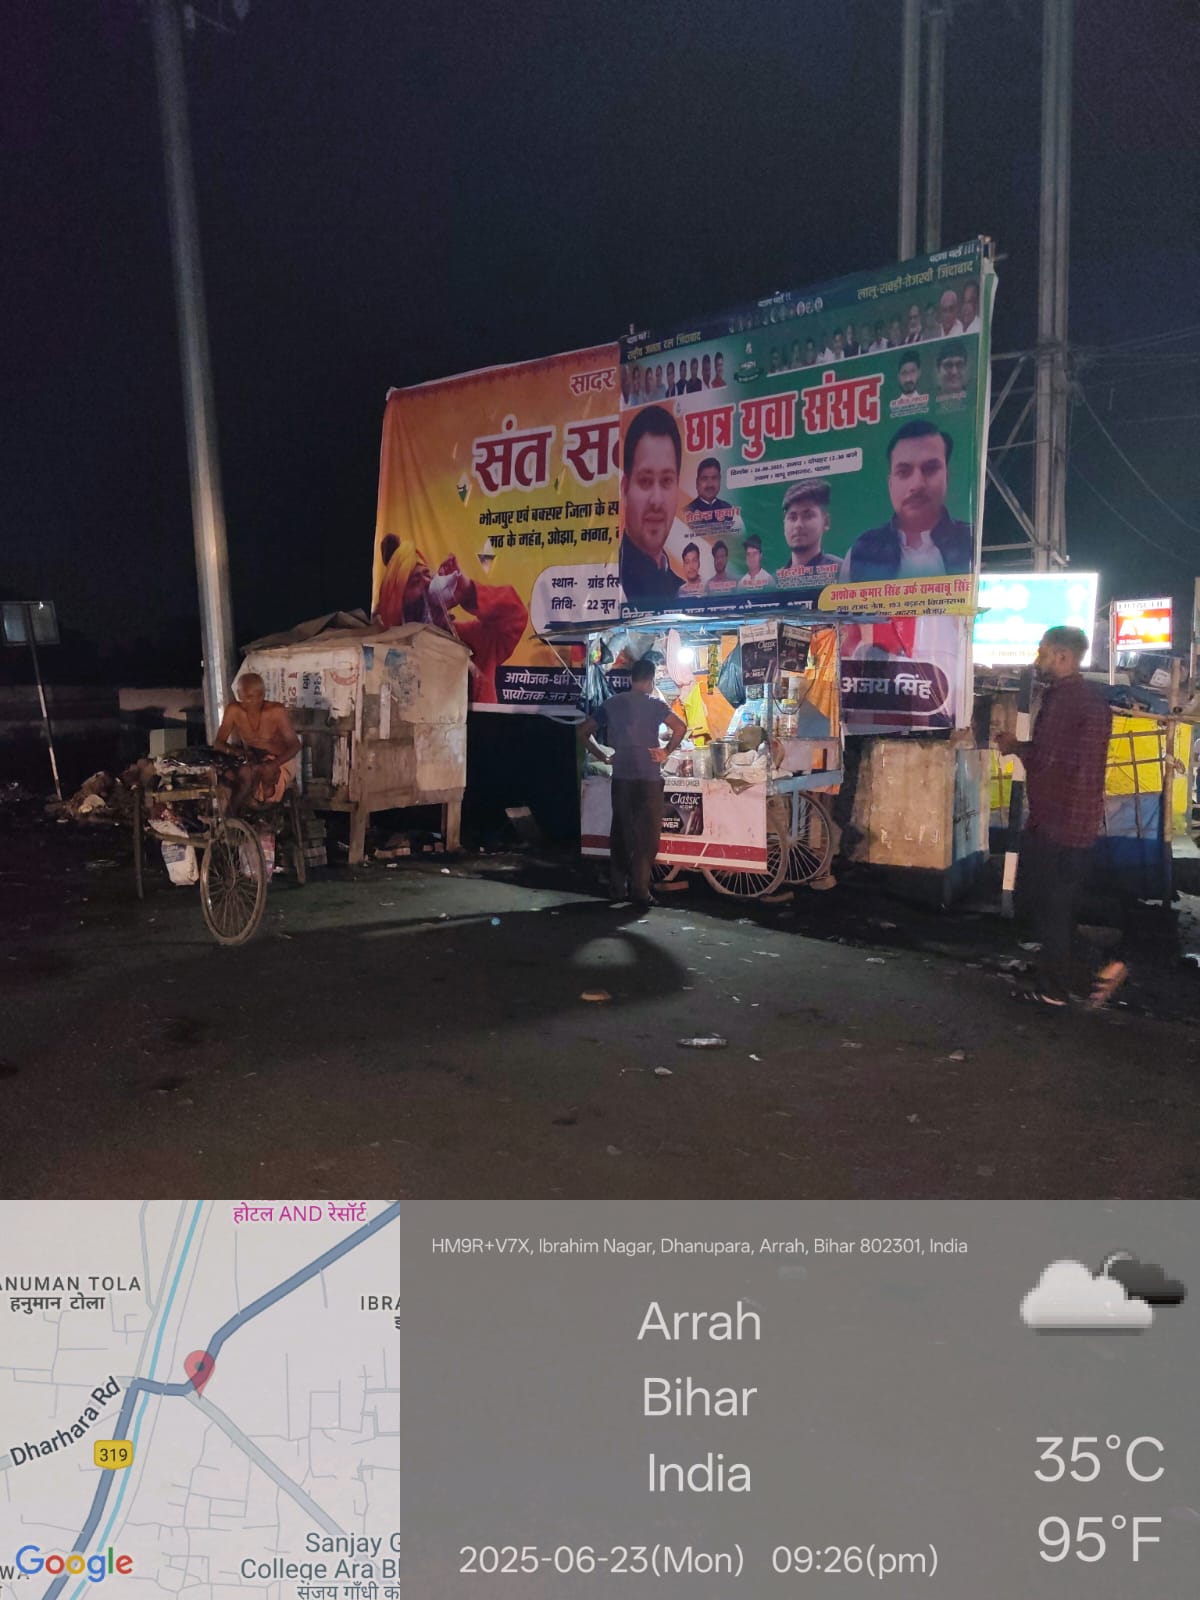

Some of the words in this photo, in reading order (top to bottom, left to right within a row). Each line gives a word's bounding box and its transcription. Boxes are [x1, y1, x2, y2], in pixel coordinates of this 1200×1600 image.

[571, 368, 616, 395] सादर
[685, 405, 734, 451] छात्र
[740, 393, 796, 459] युवा
[803, 374, 882, 432] संसद
[475, 419, 552, 492] संत
[567, 421, 619, 481] स
[479, 509, 514, 529] भोजपुर
[516, 506, 530, 524] एवं
[532, 506, 563, 521] बक्सर
[566, 501, 592, 519] जिला
[594, 498, 606, 516] के
[507, 530, 516, 548] के
[518, 529, 545, 549] महंत,
[548, 528, 577, 546] ओझा,
[581, 528, 612, 544] भगत,
[588, 575, 604, 589] ग्रांड
[830, 586, 856, 601] अशोक
[860, 587, 882, 601] कुमार
[884, 584, 900, 596] सिंह
[903, 582, 918, 596] उर्फ
[920, 582, 952, 596] रामबाबू
[552, 596, 576, 610] तिथि-
[587, 600, 598, 610] 22
[600, 599, 616, 614] जून
[841, 676, 890, 695] अजय
[895, 672, 932, 700] सिंह
[670, 793, 700, 805] Classic
